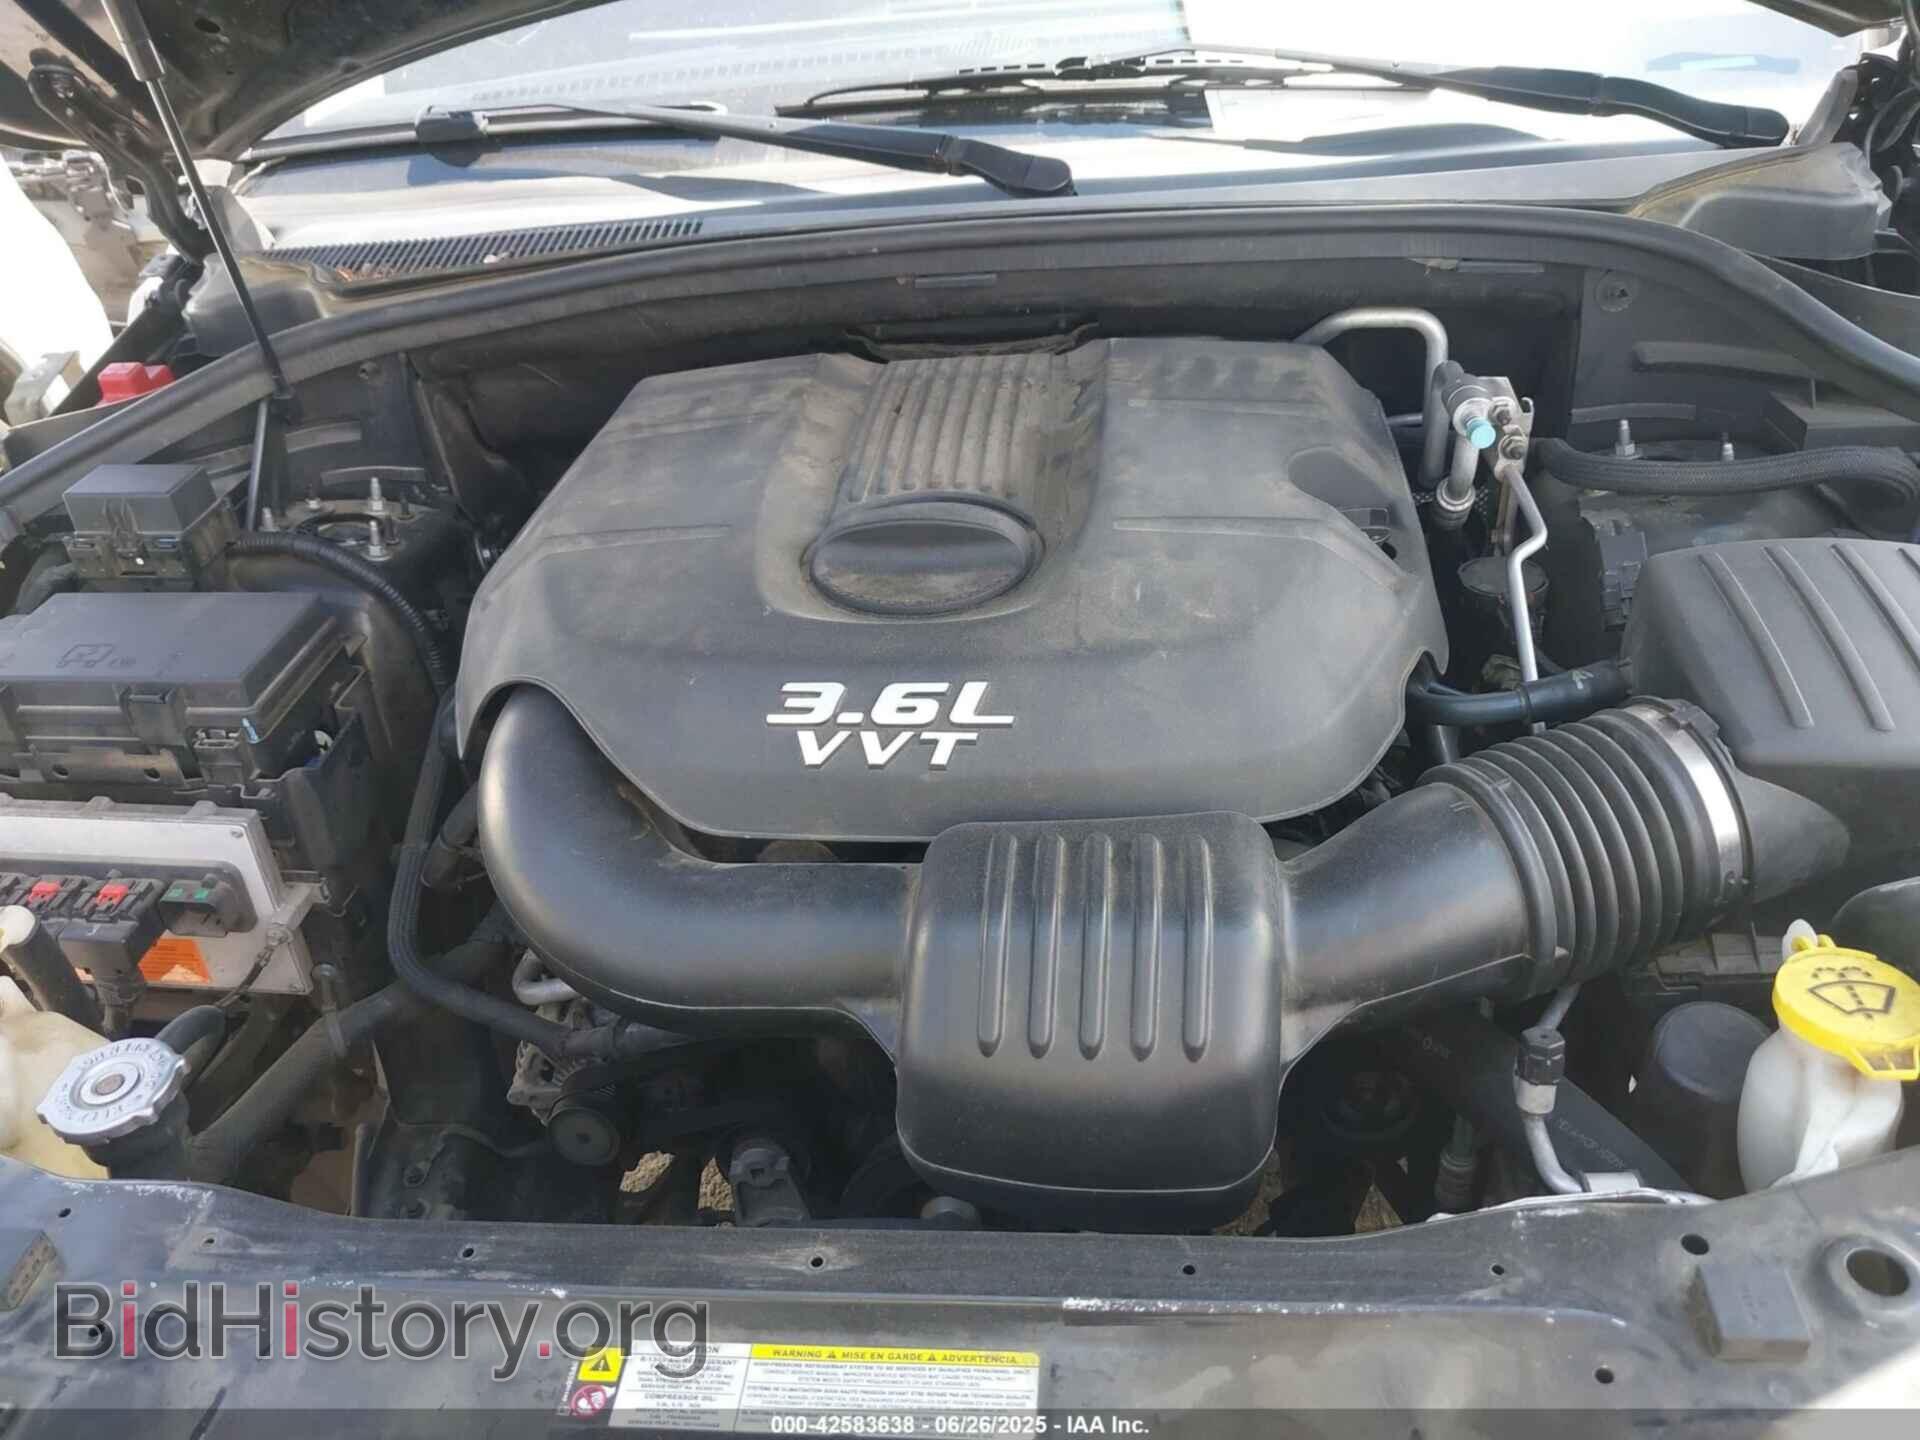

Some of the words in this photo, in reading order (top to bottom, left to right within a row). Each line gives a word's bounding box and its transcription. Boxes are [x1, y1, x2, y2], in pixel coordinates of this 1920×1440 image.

[766, 681, 1015, 727] 3.6L
[796, 730, 979, 770] VVT
[772, 1349, 823, 1359] WARNING
[842, 1351, 866, 1360] MISE
[870, 1352, 884, 1360] EN
[887, 1352, 922, 1361] GARDE
[942, 1353, 1018, 1364] ADVERTENCIA
